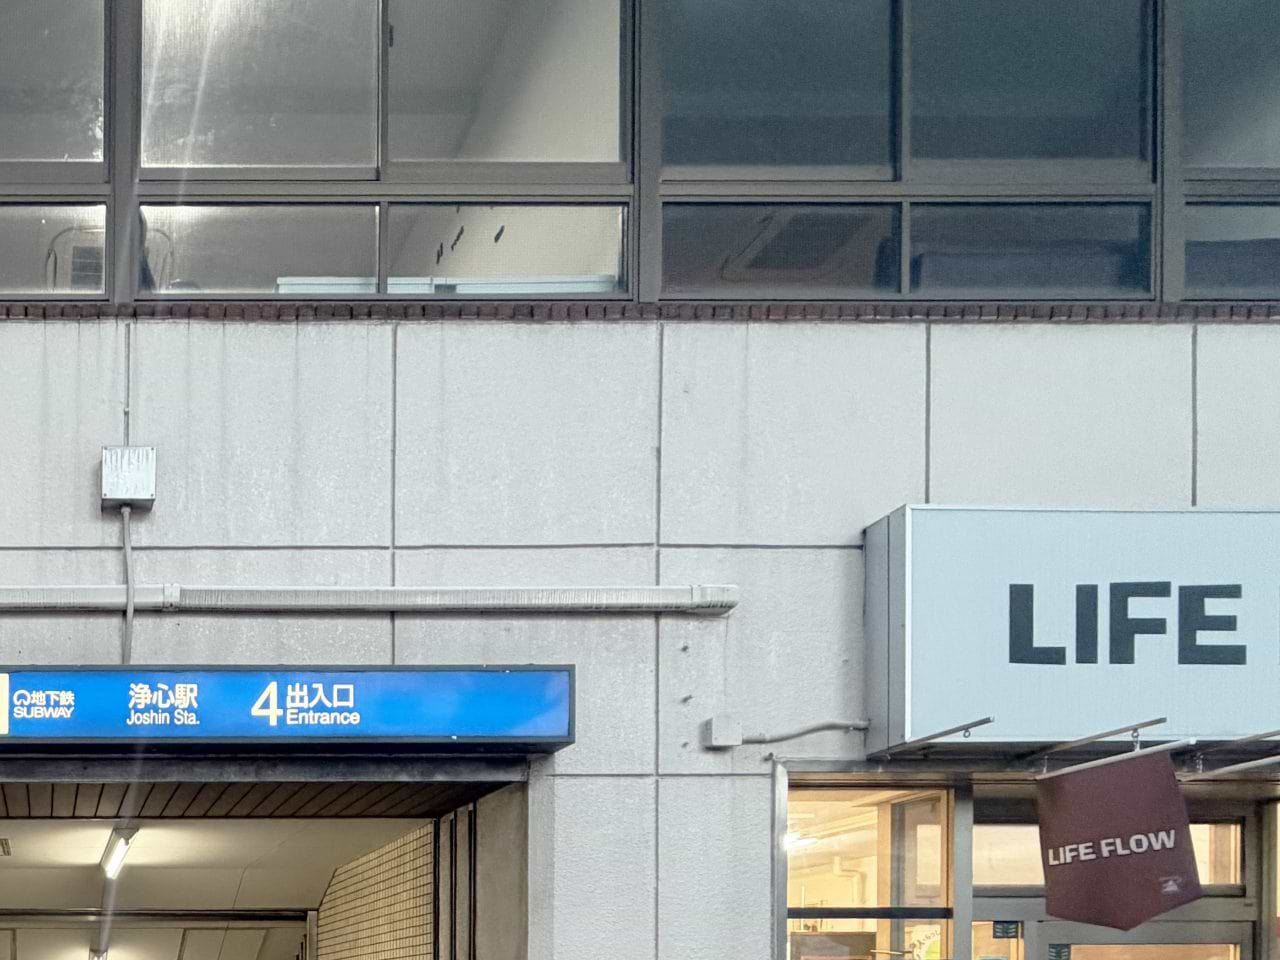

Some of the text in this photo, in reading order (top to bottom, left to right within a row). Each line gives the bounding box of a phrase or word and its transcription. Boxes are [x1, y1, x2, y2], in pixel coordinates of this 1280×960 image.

[1009, 581, 1247, 665] LIFE
[30, 690, 75, 706] 地下鉄
[128, 683, 198, 709] 浄心駅
[251, 681, 283, 726] 4
[286, 683, 354, 708] 出入口
[13, 706, 74, 719] SUBWAY
[126, 709, 200, 725] Joshin Sta.
[286, 709, 361, 725] Entrance
[1048, 829, 1176, 866] LIFE FLOW
